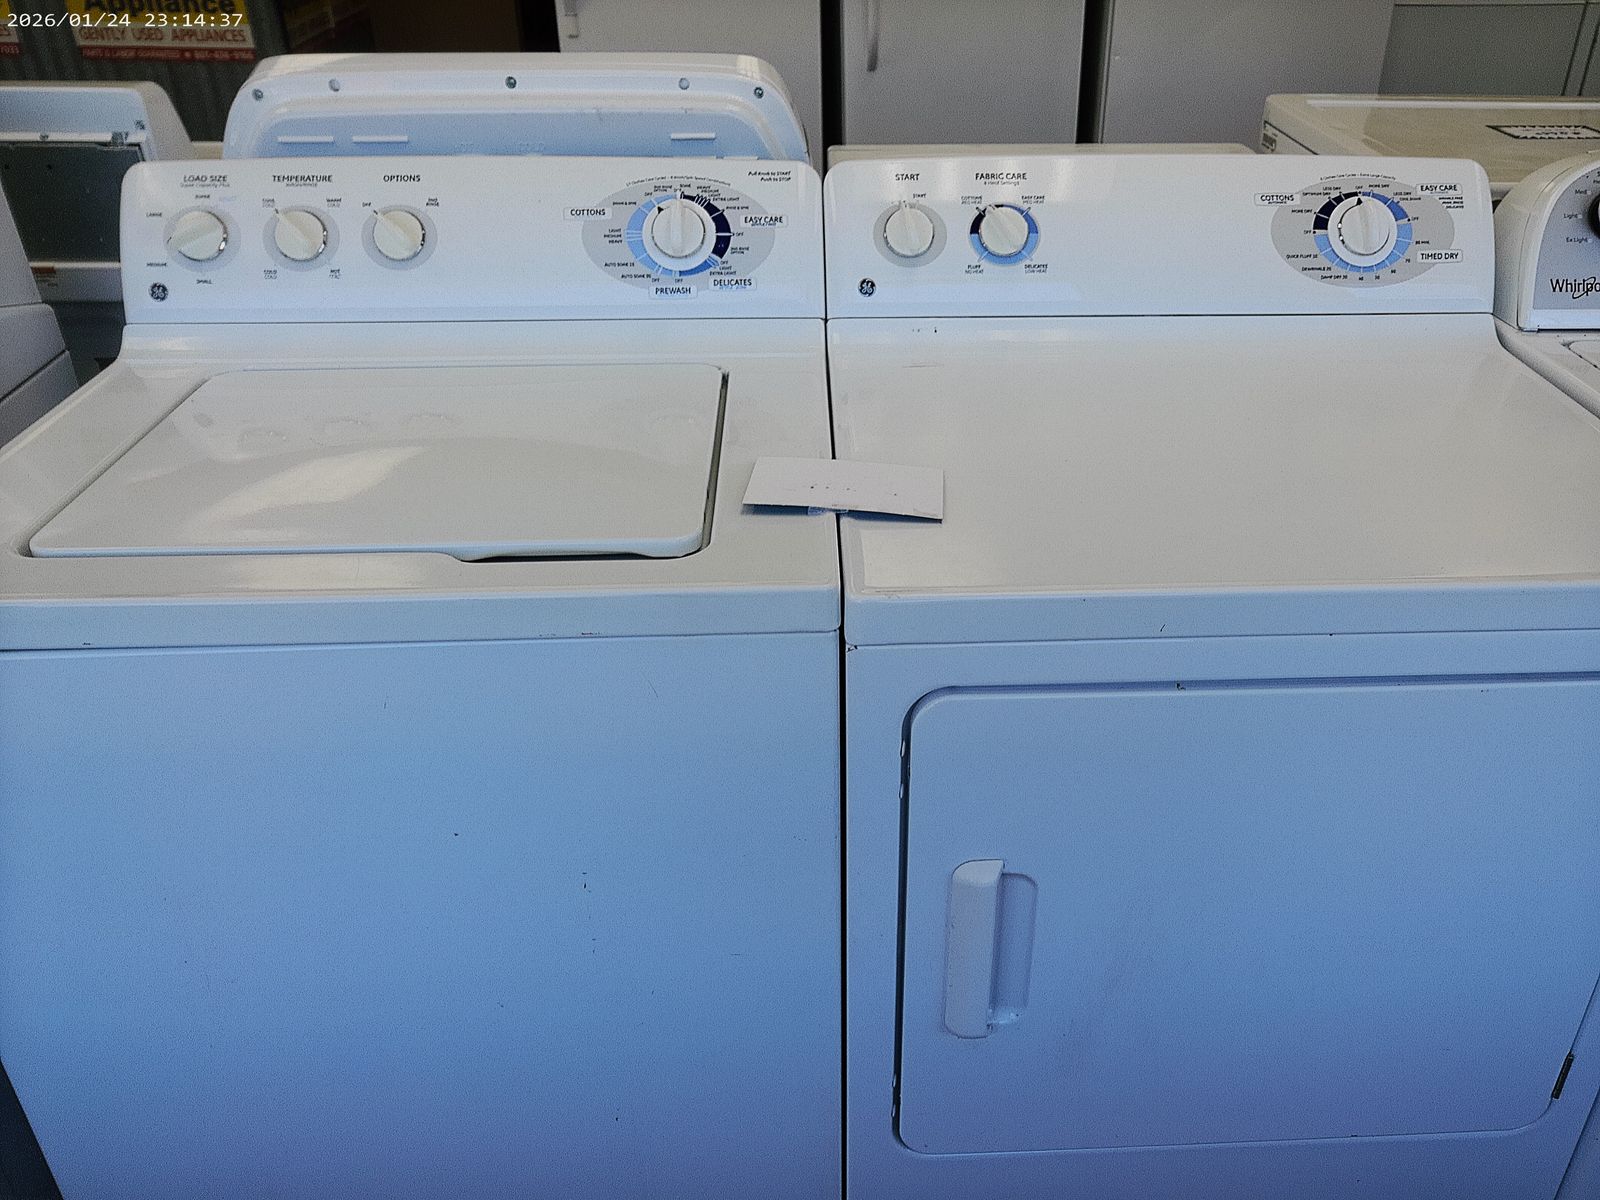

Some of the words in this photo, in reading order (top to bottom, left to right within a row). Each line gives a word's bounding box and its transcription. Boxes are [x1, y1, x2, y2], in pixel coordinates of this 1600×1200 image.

[79, 27, 126, 40] GENTLY
[131, 28, 164, 40] USED
[171, 28, 247, 42] APPLIANCES
[183, 174, 208, 182] LOAD
[210, 174, 228, 182] SIZE
[272, 174, 332, 182] TEMPERATURE
[382, 174, 421, 182] OPTIONS
[975, 172, 1004, 180] FABRIC
[1006, 172, 1028, 180] CARE
